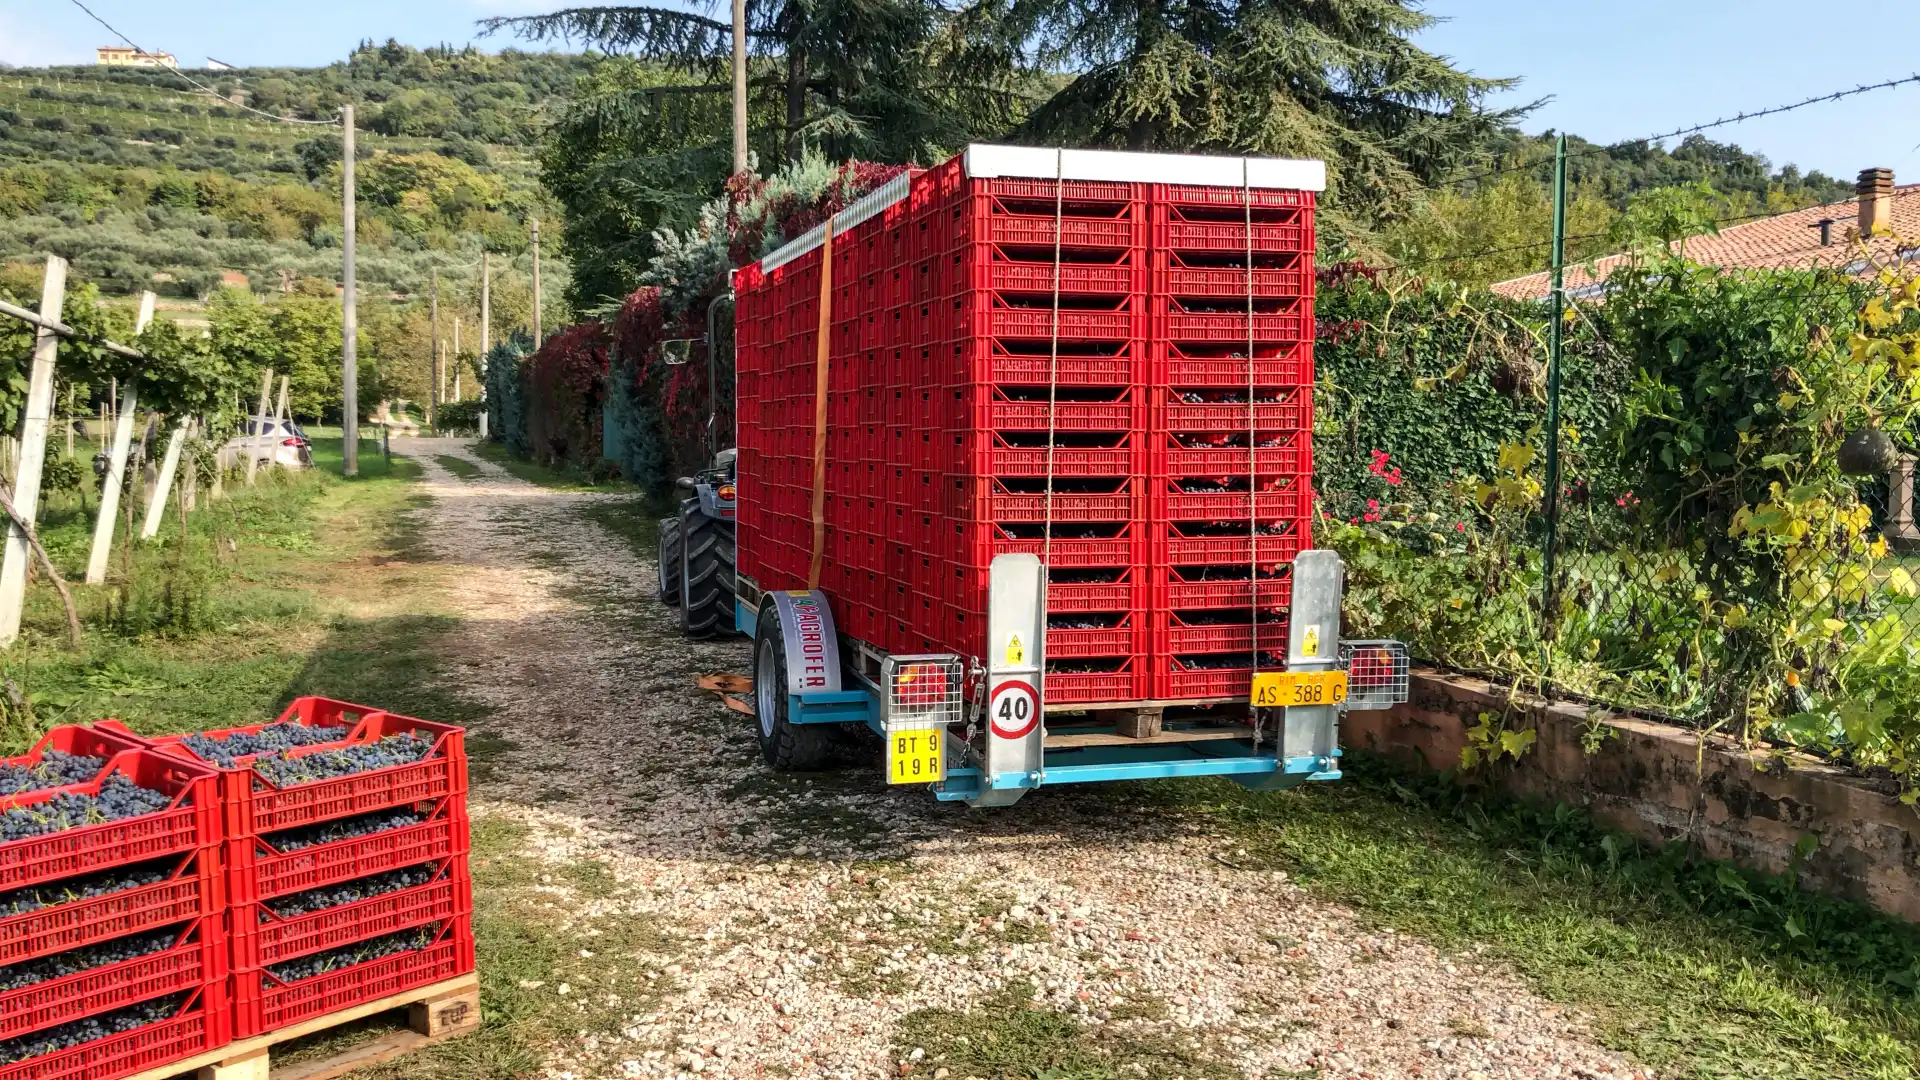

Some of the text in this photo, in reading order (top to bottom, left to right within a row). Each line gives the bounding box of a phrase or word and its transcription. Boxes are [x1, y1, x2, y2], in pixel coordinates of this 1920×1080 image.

[799, 613, 826, 688] AGROFER
[1257, 684, 1342, 704] AS 388 G
[999, 697, 1028, 721] 40
[899, 734, 938, 755] BT 9
[929, 757, 938, 774] R
